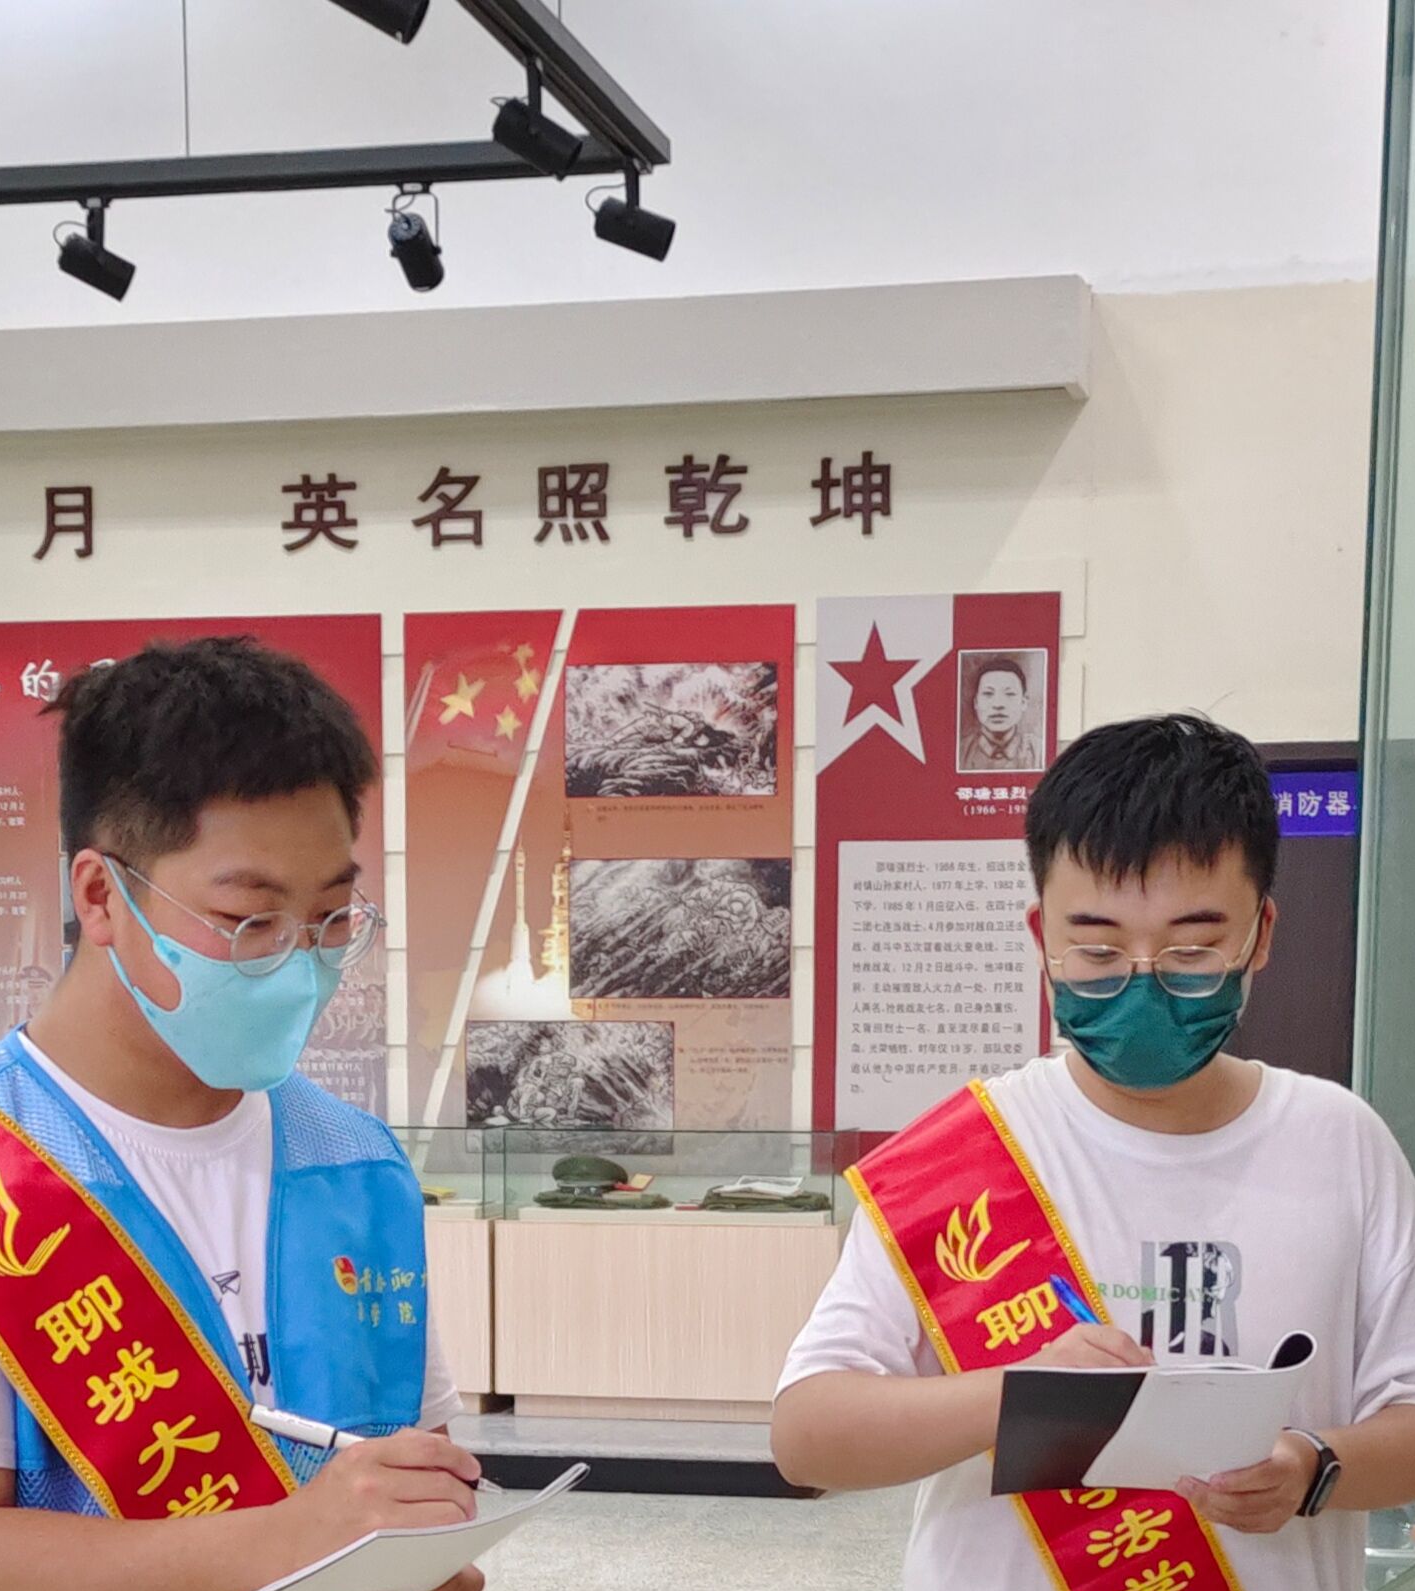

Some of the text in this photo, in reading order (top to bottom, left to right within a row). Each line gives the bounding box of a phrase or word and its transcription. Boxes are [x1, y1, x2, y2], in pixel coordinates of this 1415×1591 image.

[281, 450, 893, 553] 英名照乾坤
[1272, 790, 1357, 817] 消防器
[976, 1281, 1061, 1352] 聊
[35, 1274, 240, 1519] 聊城大学
